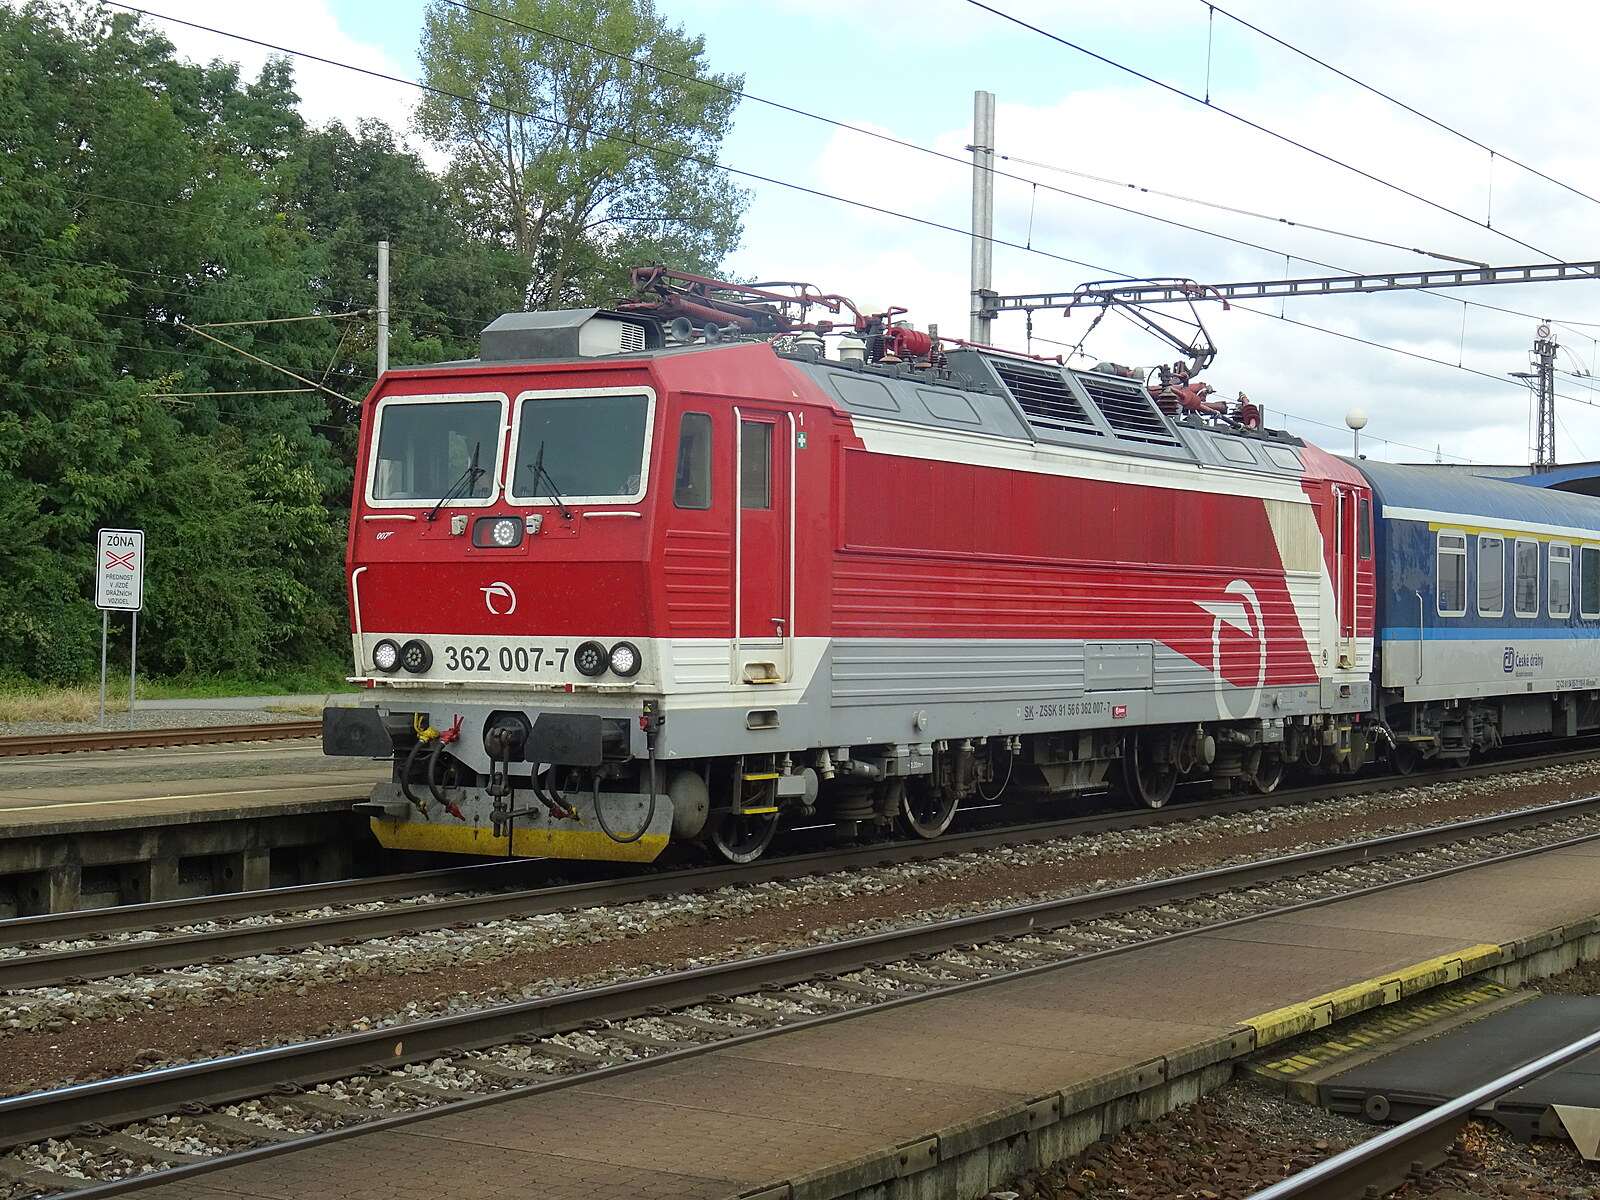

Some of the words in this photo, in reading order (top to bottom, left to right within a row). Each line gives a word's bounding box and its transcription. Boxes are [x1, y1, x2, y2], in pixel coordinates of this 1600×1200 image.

[798, 411, 804, 426] 1
[107, 534, 135, 547] ZÓNA
[105, 573, 133, 581] PŘEDNOST
[108, 597, 129, 605] VOZIDEL
[445, 646, 491, 671] 362
[499, 646, 570, 673] 007-7
[1024, 705, 1034, 718] SK
[1039, 704, 1058, 717] ZSSK
[1058, 704, 1066, 716] 91
[1080, 702, 1092, 715] 362
[1092, 701, 1111, 714] 007-7
